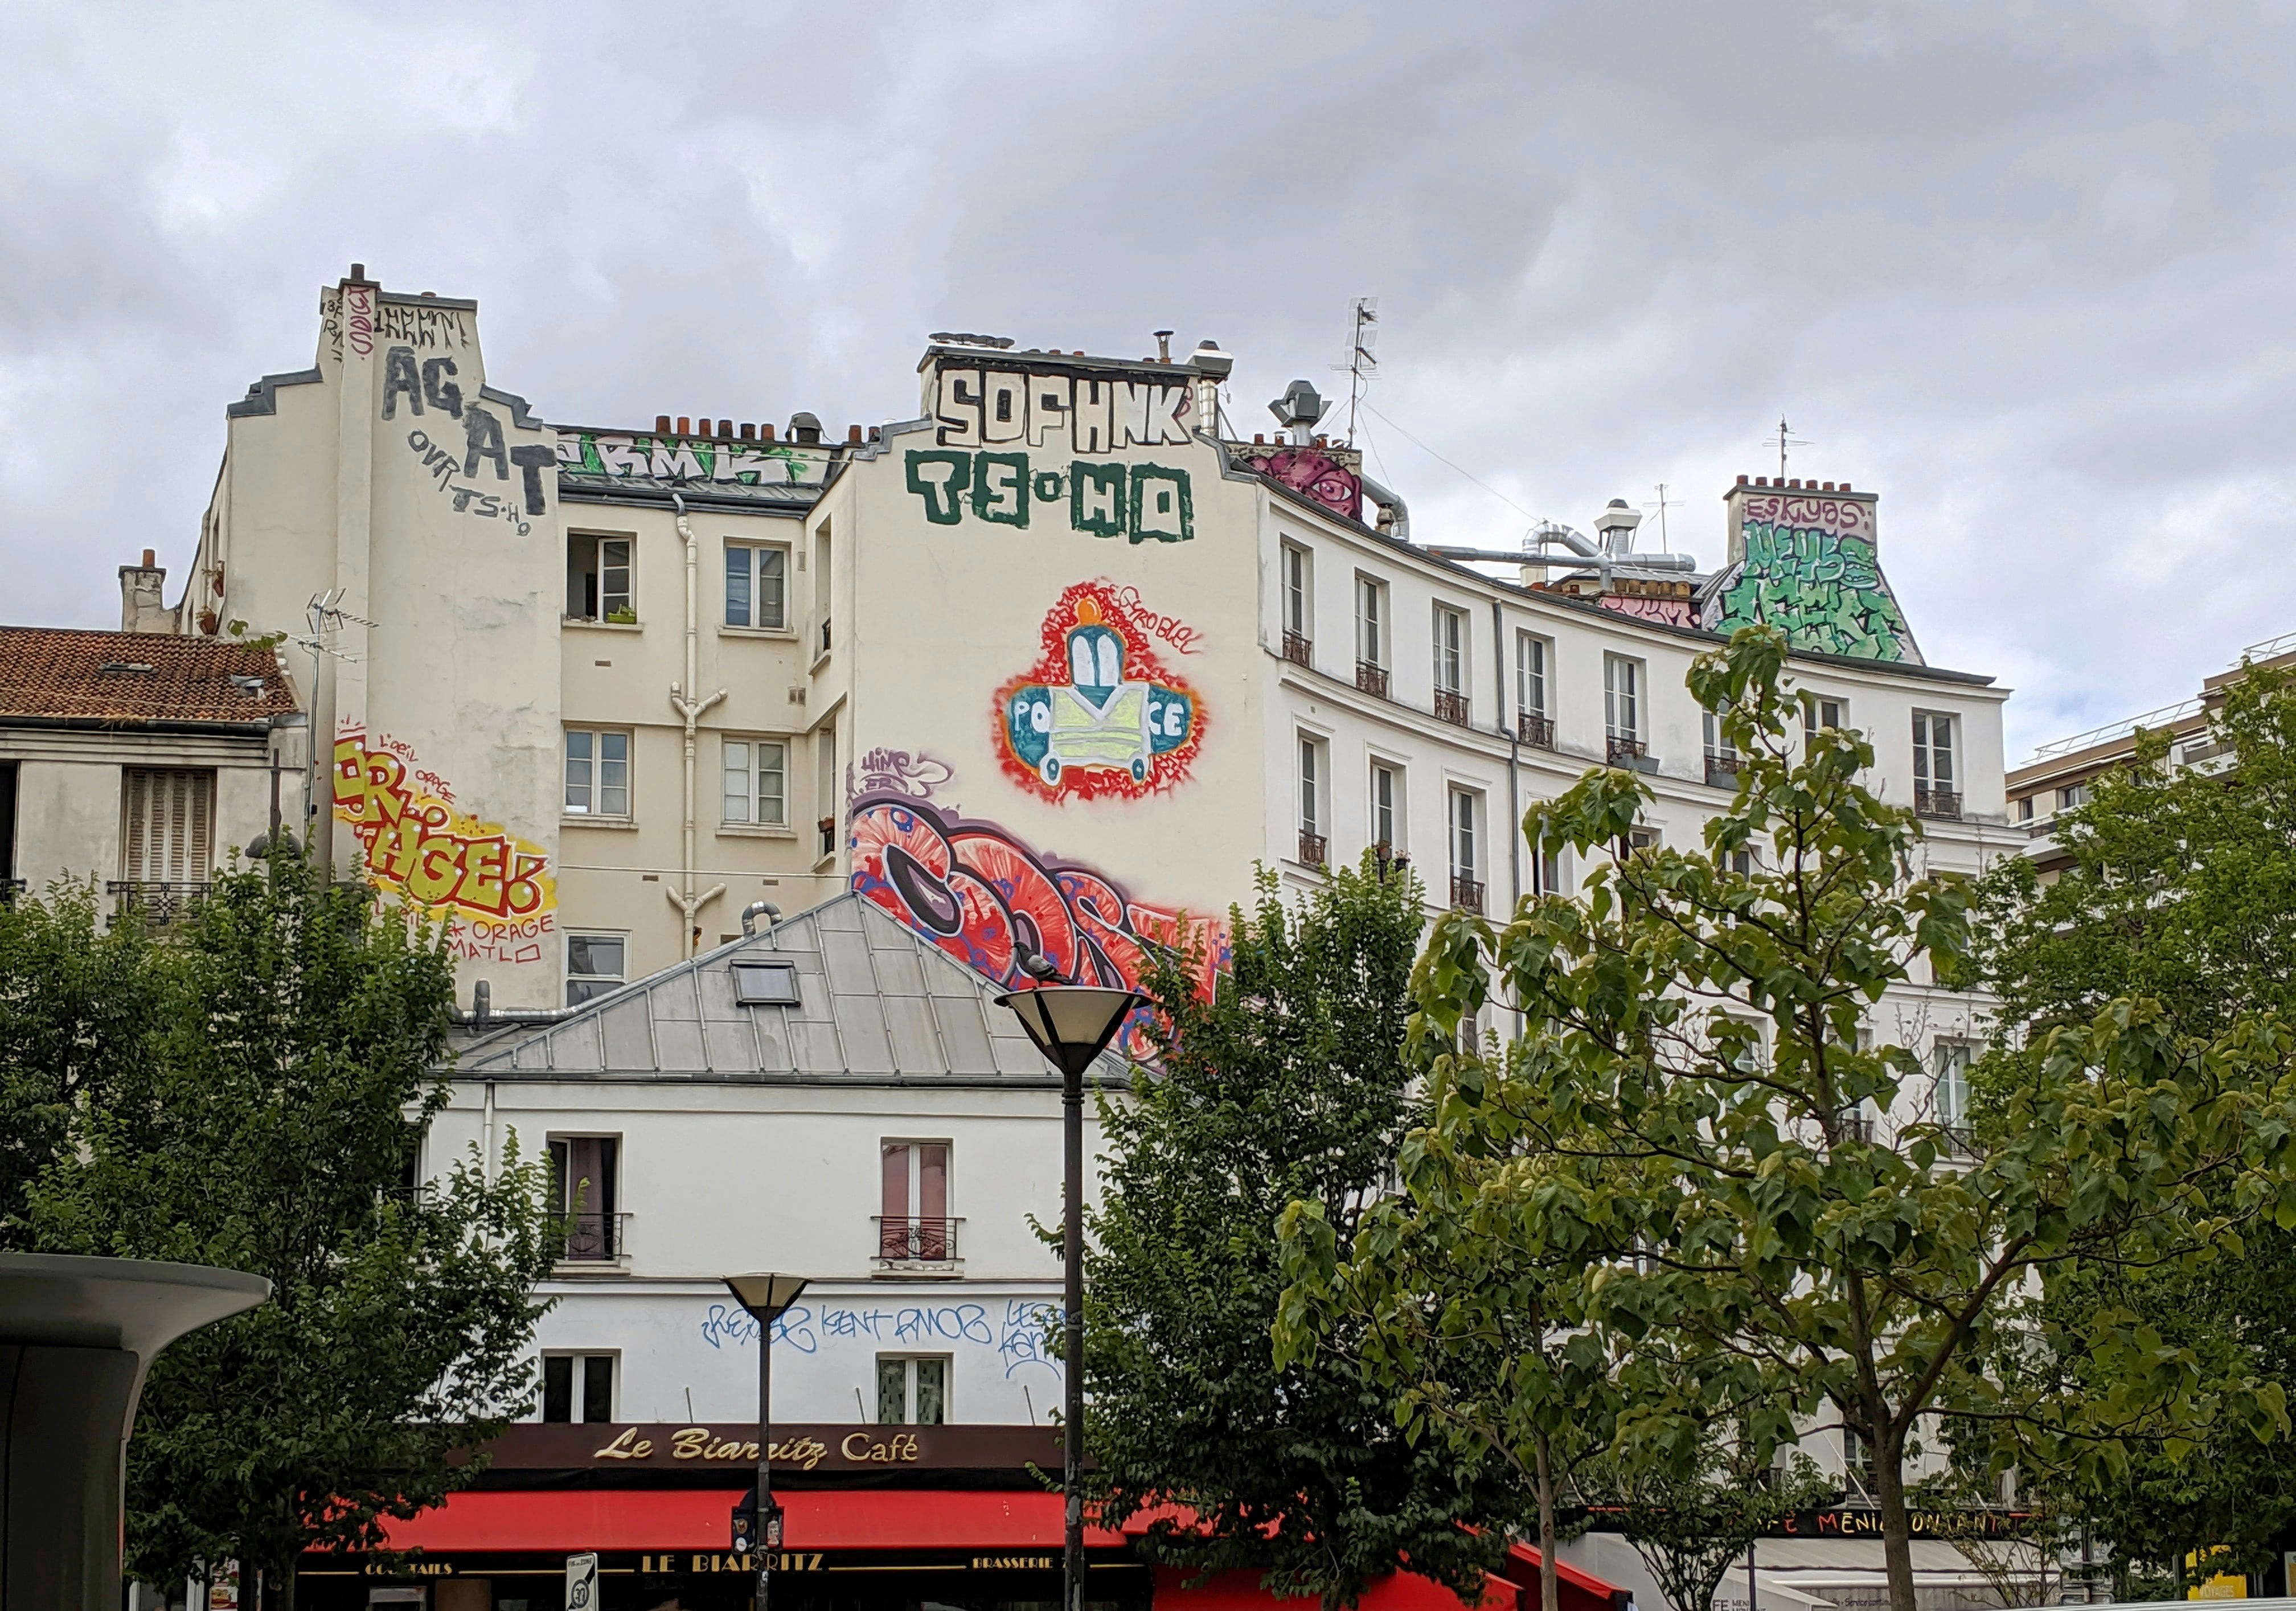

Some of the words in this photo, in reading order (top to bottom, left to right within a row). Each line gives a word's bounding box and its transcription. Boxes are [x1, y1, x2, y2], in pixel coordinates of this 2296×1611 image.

[473, 914, 555, 945] ORAGE
[593, 1426, 654, 1460] Le
[841, 1432, 918, 1462] Café
[642, 1555, 675, 1573] LE
[692, 1553, 823, 1572] BIARRITZ
[973, 1557, 1053, 1568] BRASSERIE
